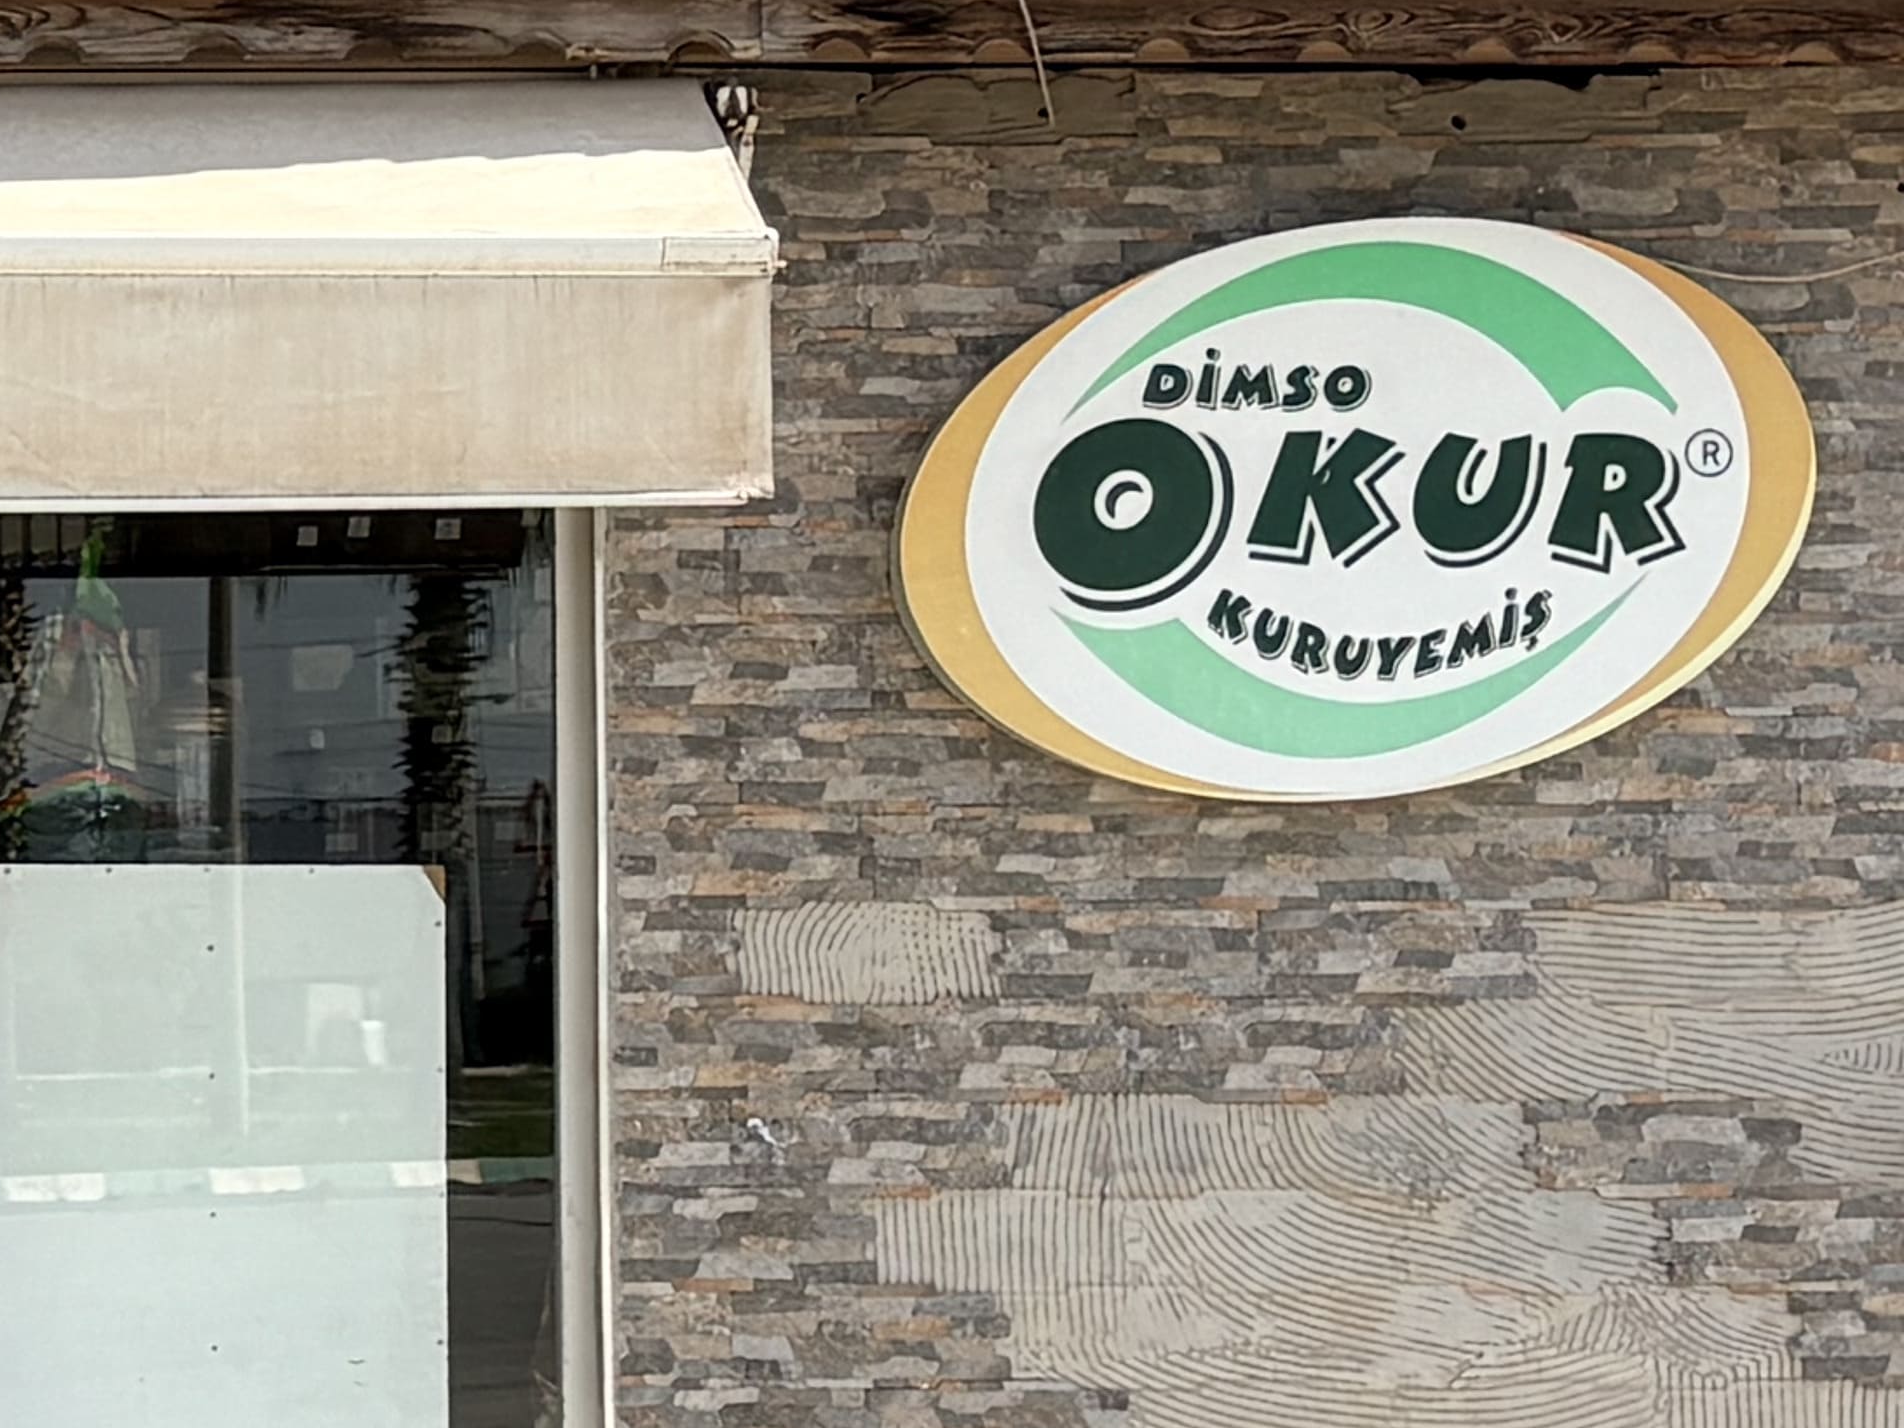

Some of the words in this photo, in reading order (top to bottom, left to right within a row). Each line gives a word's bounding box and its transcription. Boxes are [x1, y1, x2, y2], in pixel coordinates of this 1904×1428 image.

[1142, 348, 1372, 412] DİMSO
[1033, 417, 1686, 612] OKUR
[1206, 587, 1555, 682] KURUYEMİŞ
